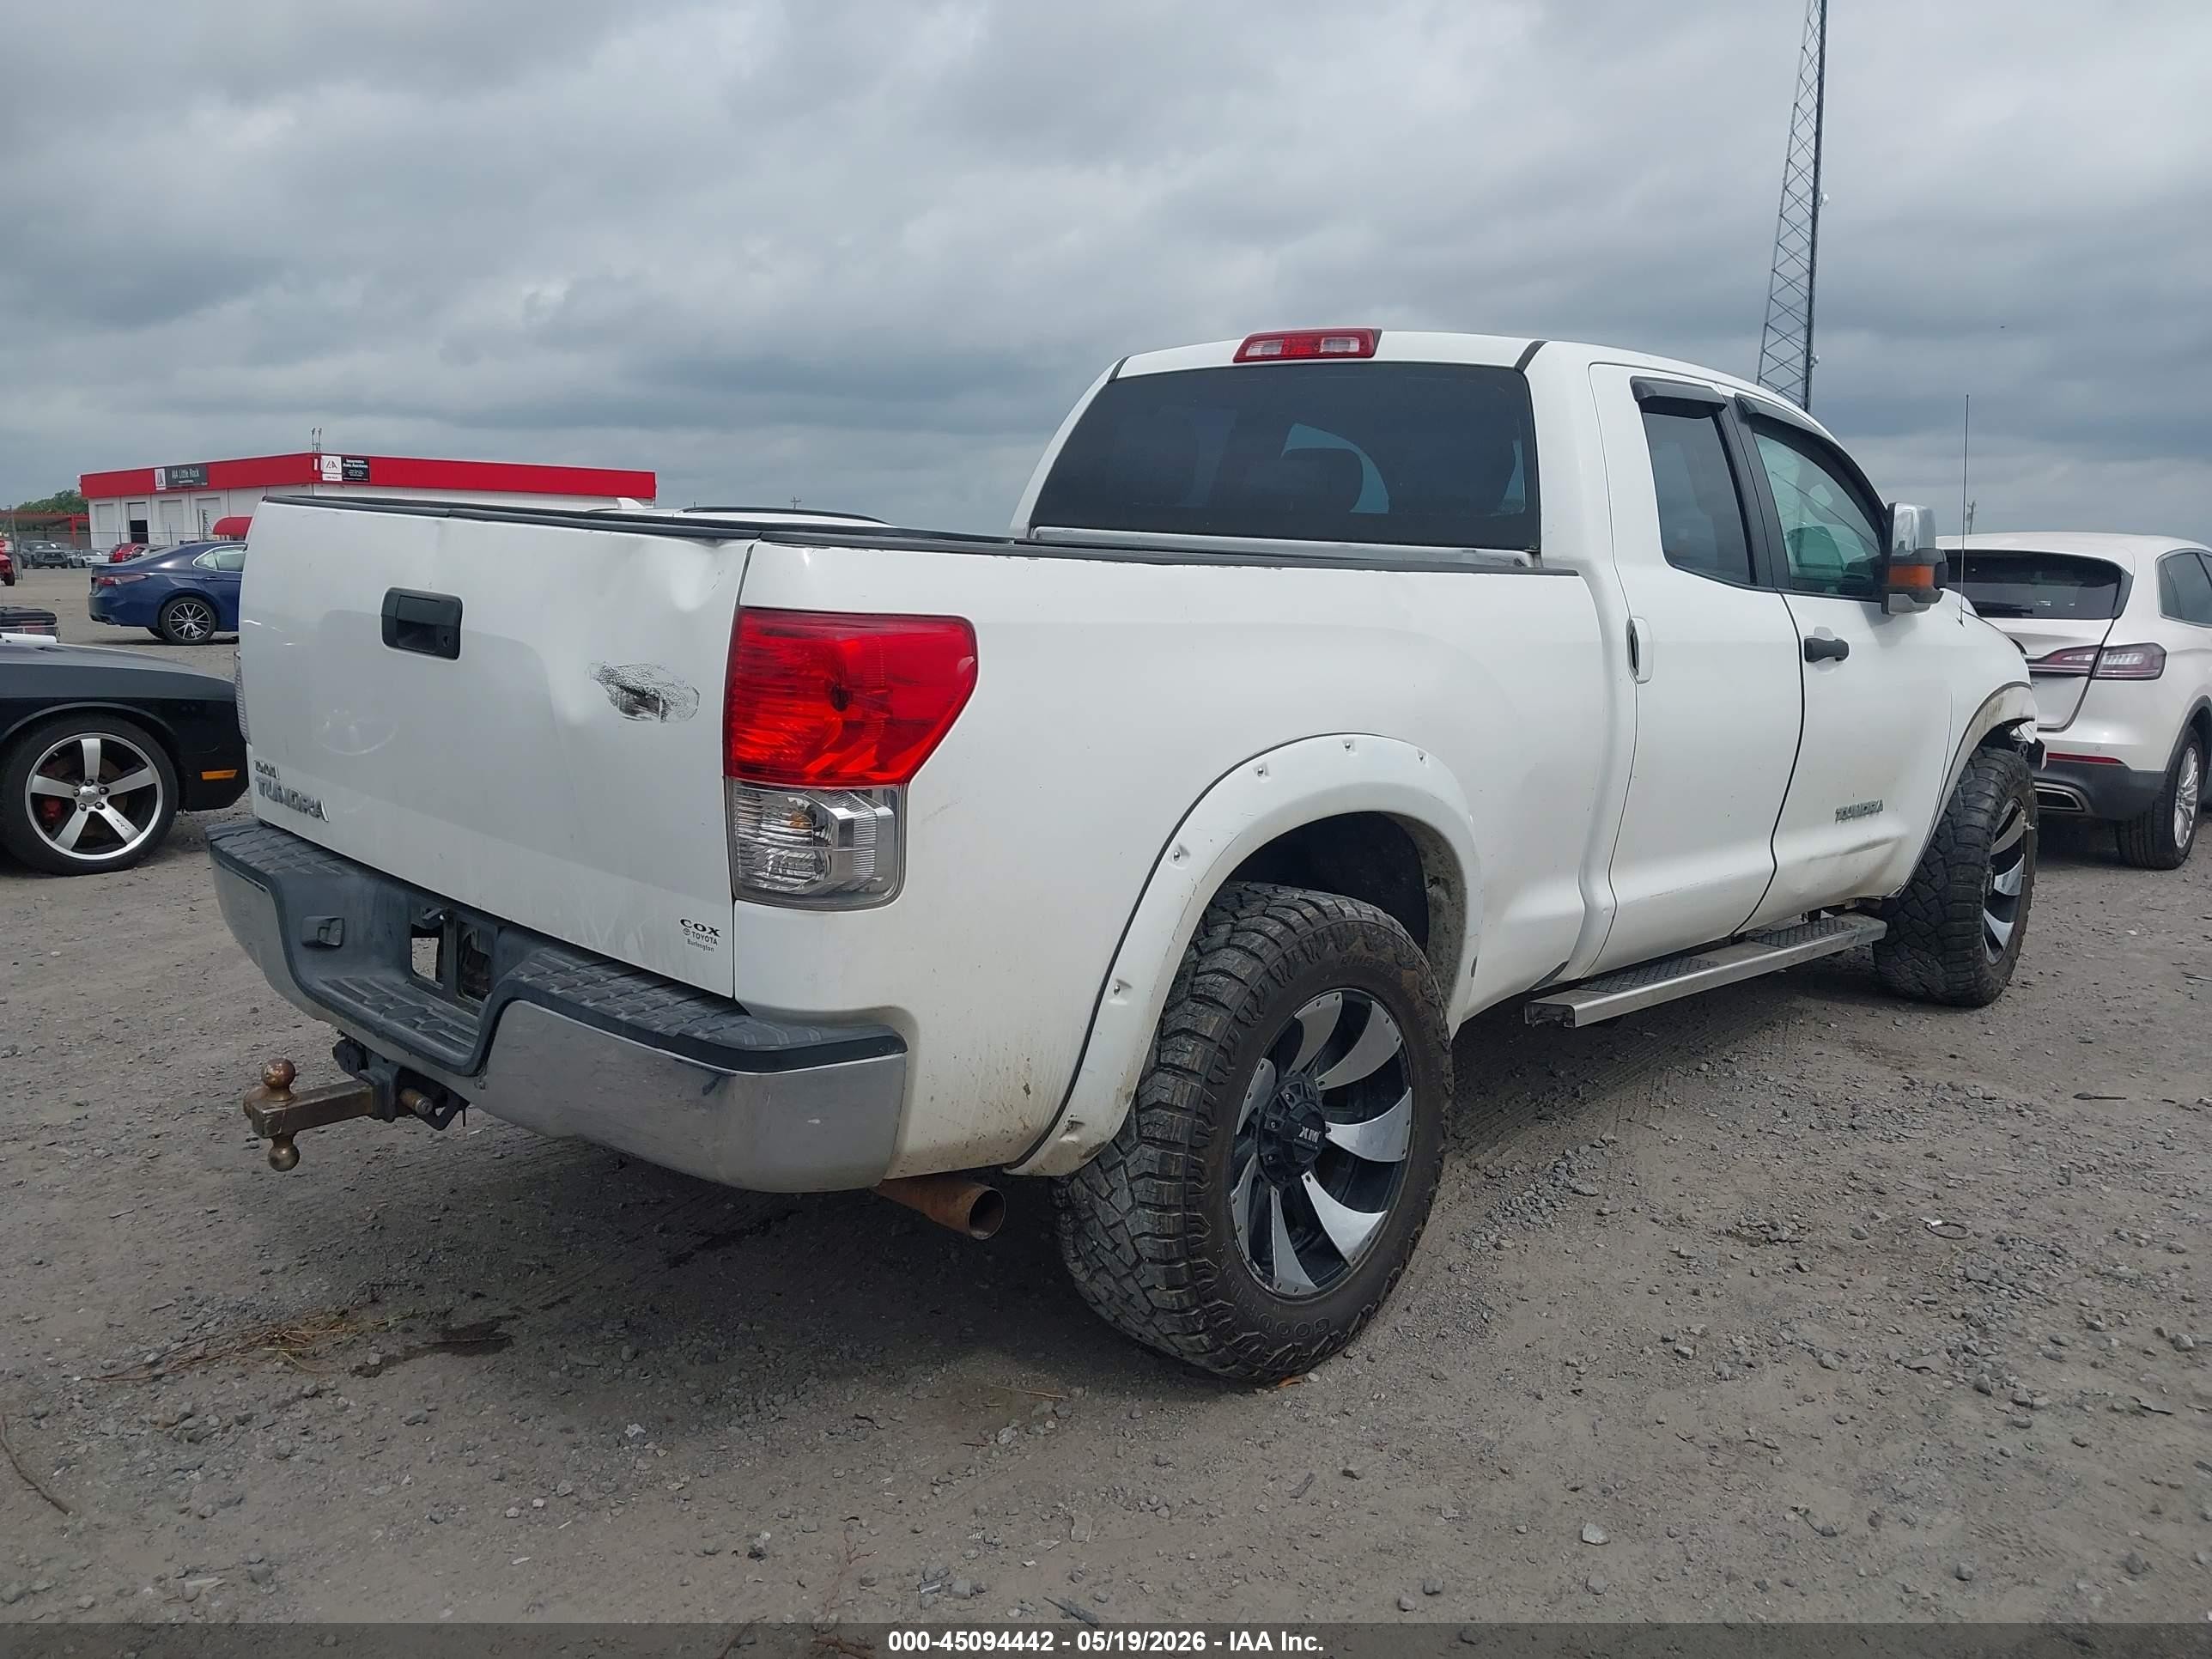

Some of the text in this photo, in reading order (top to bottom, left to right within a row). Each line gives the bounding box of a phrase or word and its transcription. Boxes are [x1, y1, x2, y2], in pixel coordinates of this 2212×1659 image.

[254, 775, 329, 823] TUNDRA
[679, 918, 721, 938] COX
[691, 931, 718, 946] TOYOTA
